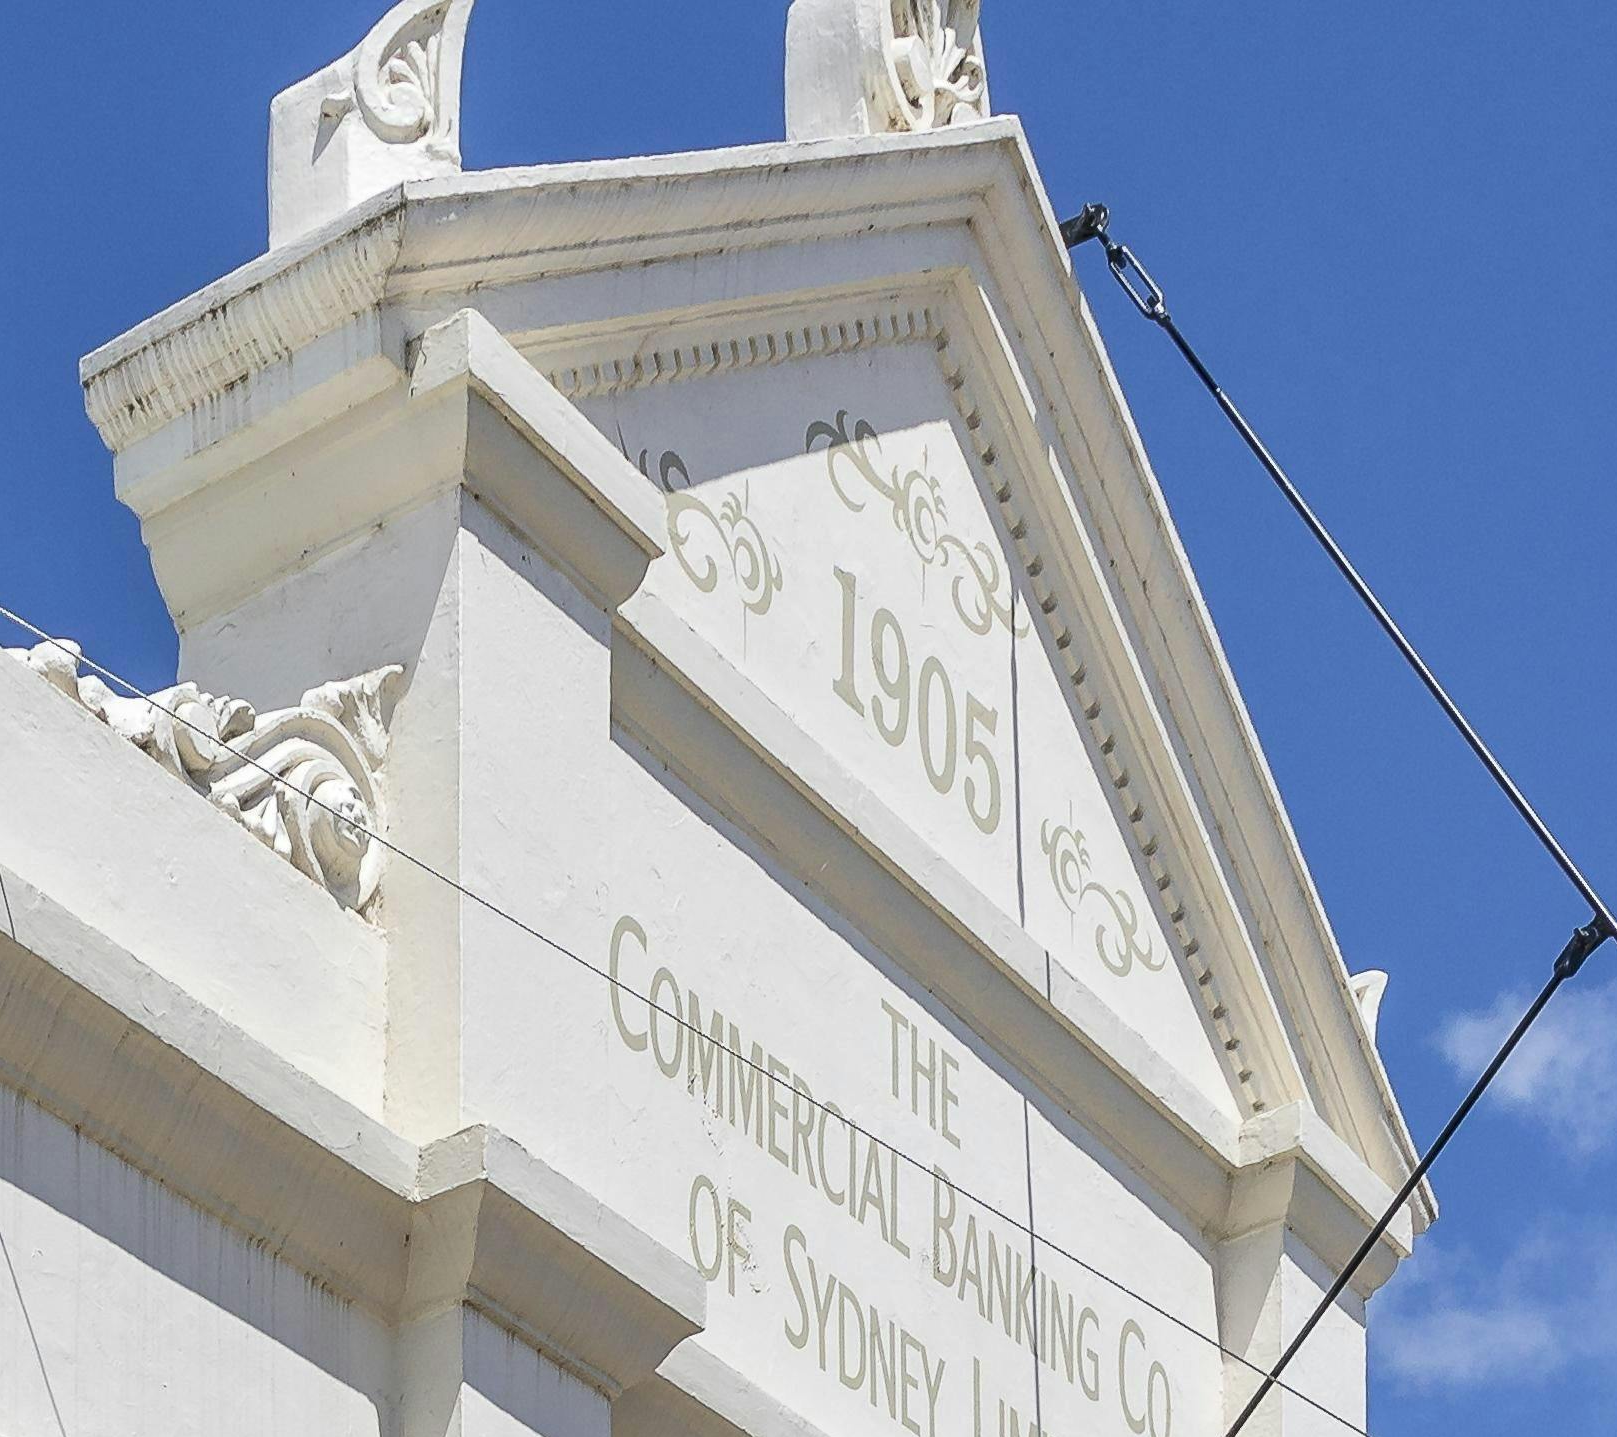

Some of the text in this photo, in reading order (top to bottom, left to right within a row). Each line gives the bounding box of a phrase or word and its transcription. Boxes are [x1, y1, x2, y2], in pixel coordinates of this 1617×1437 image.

[833, 568, 1001, 835] 1905
[609, 915, 910, 1260] COMMERCIAL
[932, 1164, 1100, 1402] BANKING
[881, 998, 961, 1149] THE
[688, 1174, 754, 1296] OF
